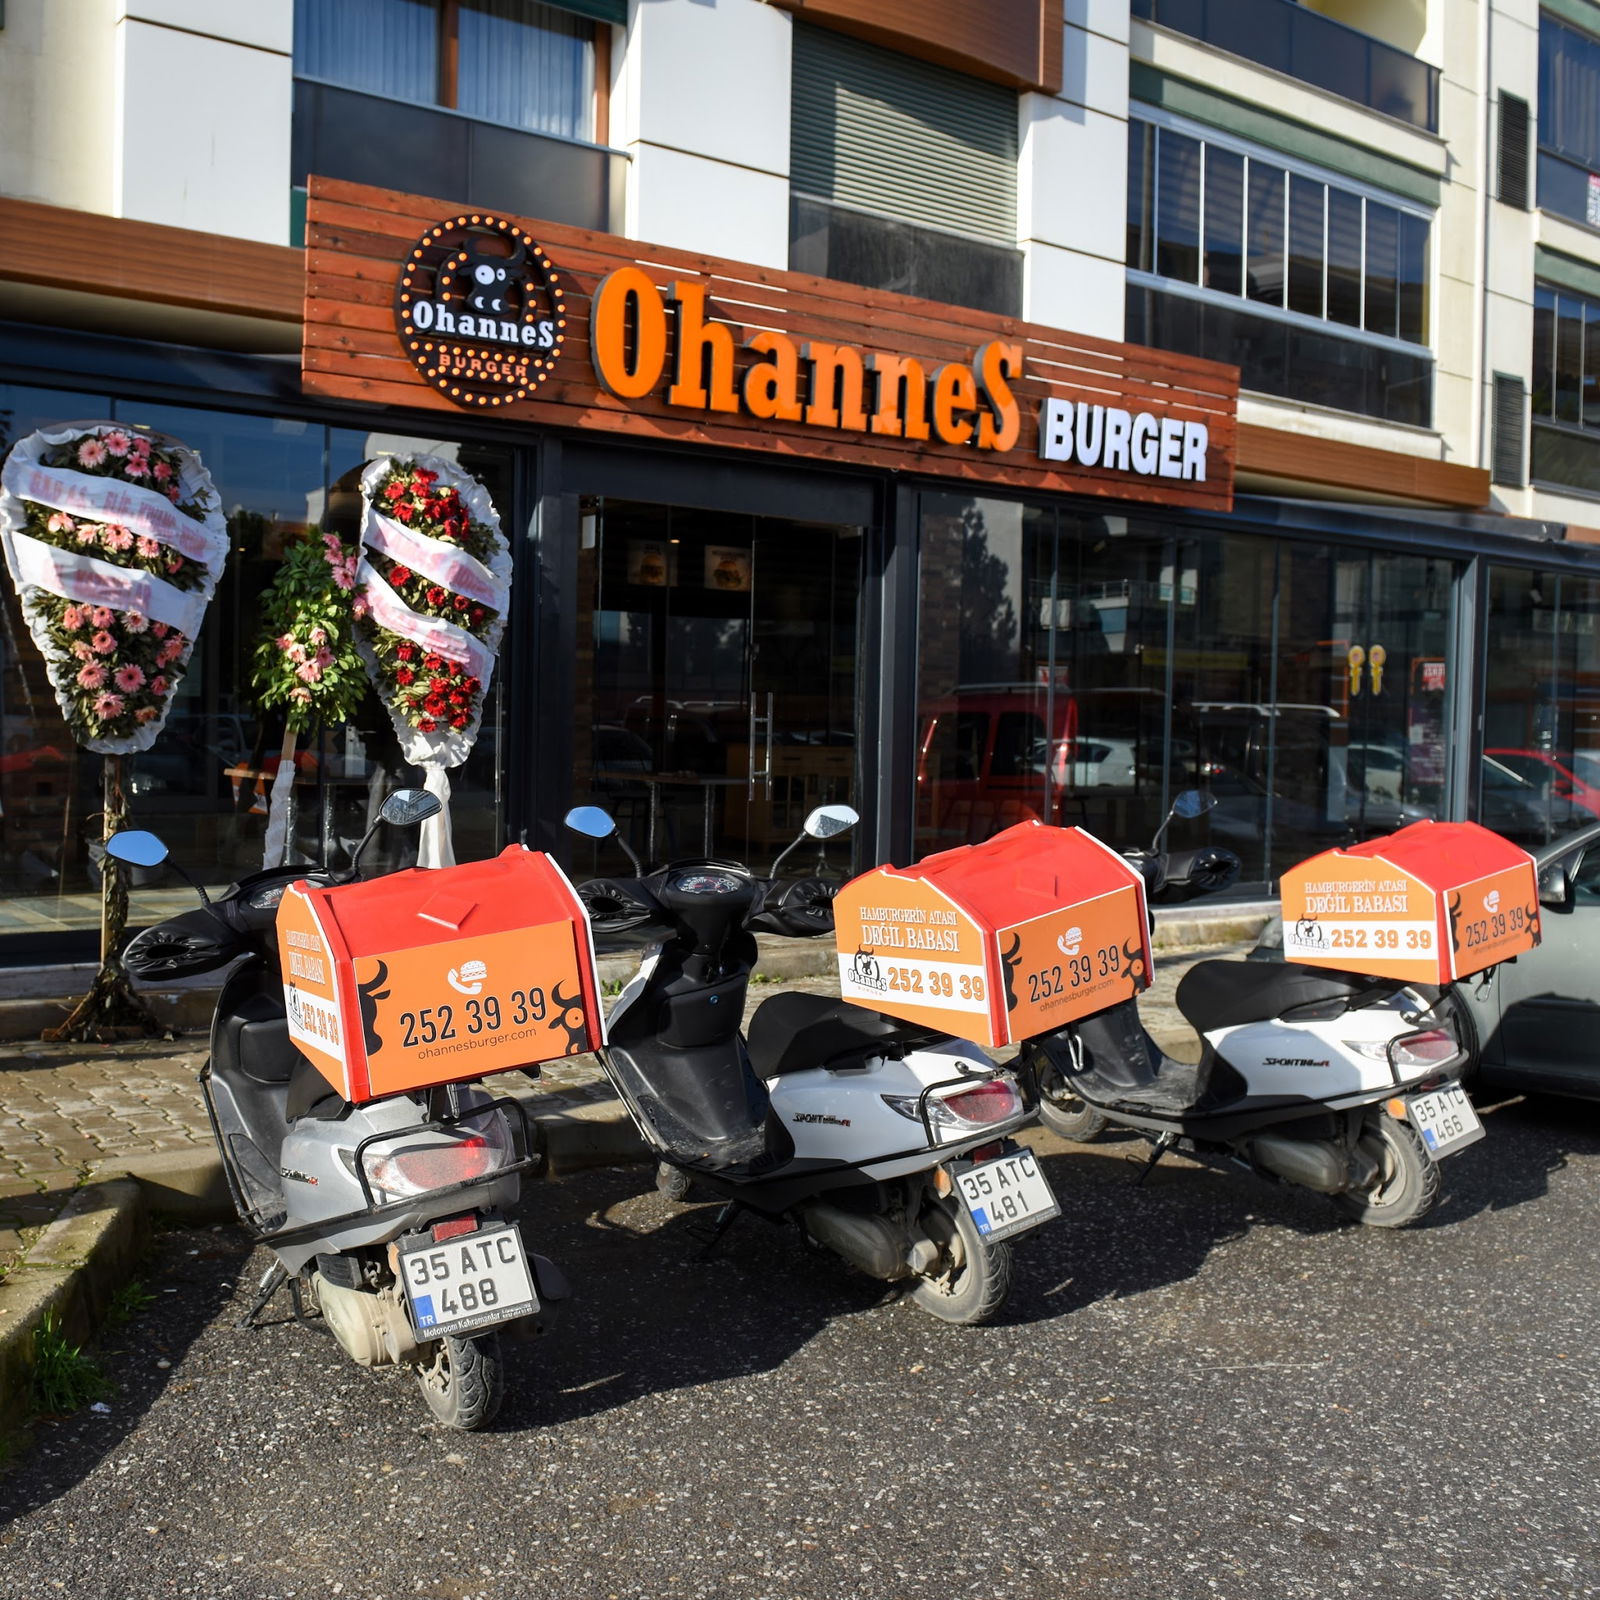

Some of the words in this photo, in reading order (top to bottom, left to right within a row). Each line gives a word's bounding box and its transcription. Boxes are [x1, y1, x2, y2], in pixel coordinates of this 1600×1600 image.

[413, 301, 554, 347] OhanneS
[439, 354, 527, 376] BURGER
[591, 266, 1022, 452] OhanneS
[1041, 397, 1208, 481] BURGER
[1304, 879, 1376, 894] HAMBURGERİN
[1378, 880, 1408, 892] ATASI
[859, 906, 927, 924] HAMBURGERİN
[929, 910, 957, 926] ATASI
[1305, 894, 1350, 913] DEĞİL
[1353, 895, 1408, 913] BABASI
[862, 922, 904, 948] DEĞİL
[906, 927, 960, 952] BABASI
[1331, 929, 1368, 948] 252
[1374, 929, 1399, 949] 39
[1406, 930, 1432, 949] 39
[1465, 920, 1488, 948] 252
[1491, 913, 1506, 938] 39
[1509, 906, 1524, 931] 39
[887, 967, 924, 994] 252
[928, 971, 953, 997] 39
[960, 975, 985, 1001] 39
[1028, 965, 1064, 1003] 252
[1069, 955, 1092, 987] 39
[1097, 945, 1120, 977] 39
[1039, 979, 1114, 1012] ohannesburger.com
[302, 1002, 317, 1035] 252
[317, 1008, 328, 1040] 39
[328, 1012, 339, 1046] 39
[400, 1005, 456, 1048] 252
[465, 996, 501, 1034] 39
[511, 987, 546, 1025] 39
[418, 1028, 537, 1059] ohannesburger.com
[1415, 1100, 1436, 1122] 35
[1437, 1087, 1464, 1112] ATC
[1435, 1115, 1463, 1140] 466
[963, 1172, 992, 1200] 35
[995, 1156, 1035, 1189] ATC
[990, 1190, 1029, 1222] 481
[980, 1223, 991, 1233] TR
[410, 1252, 450, 1285] 35
[460, 1236, 516, 1275] ATC
[441, 1278, 499, 1315] 488
[420, 1315, 434, 1327] TR
[424, 1324, 458, 1338] Motoroom
